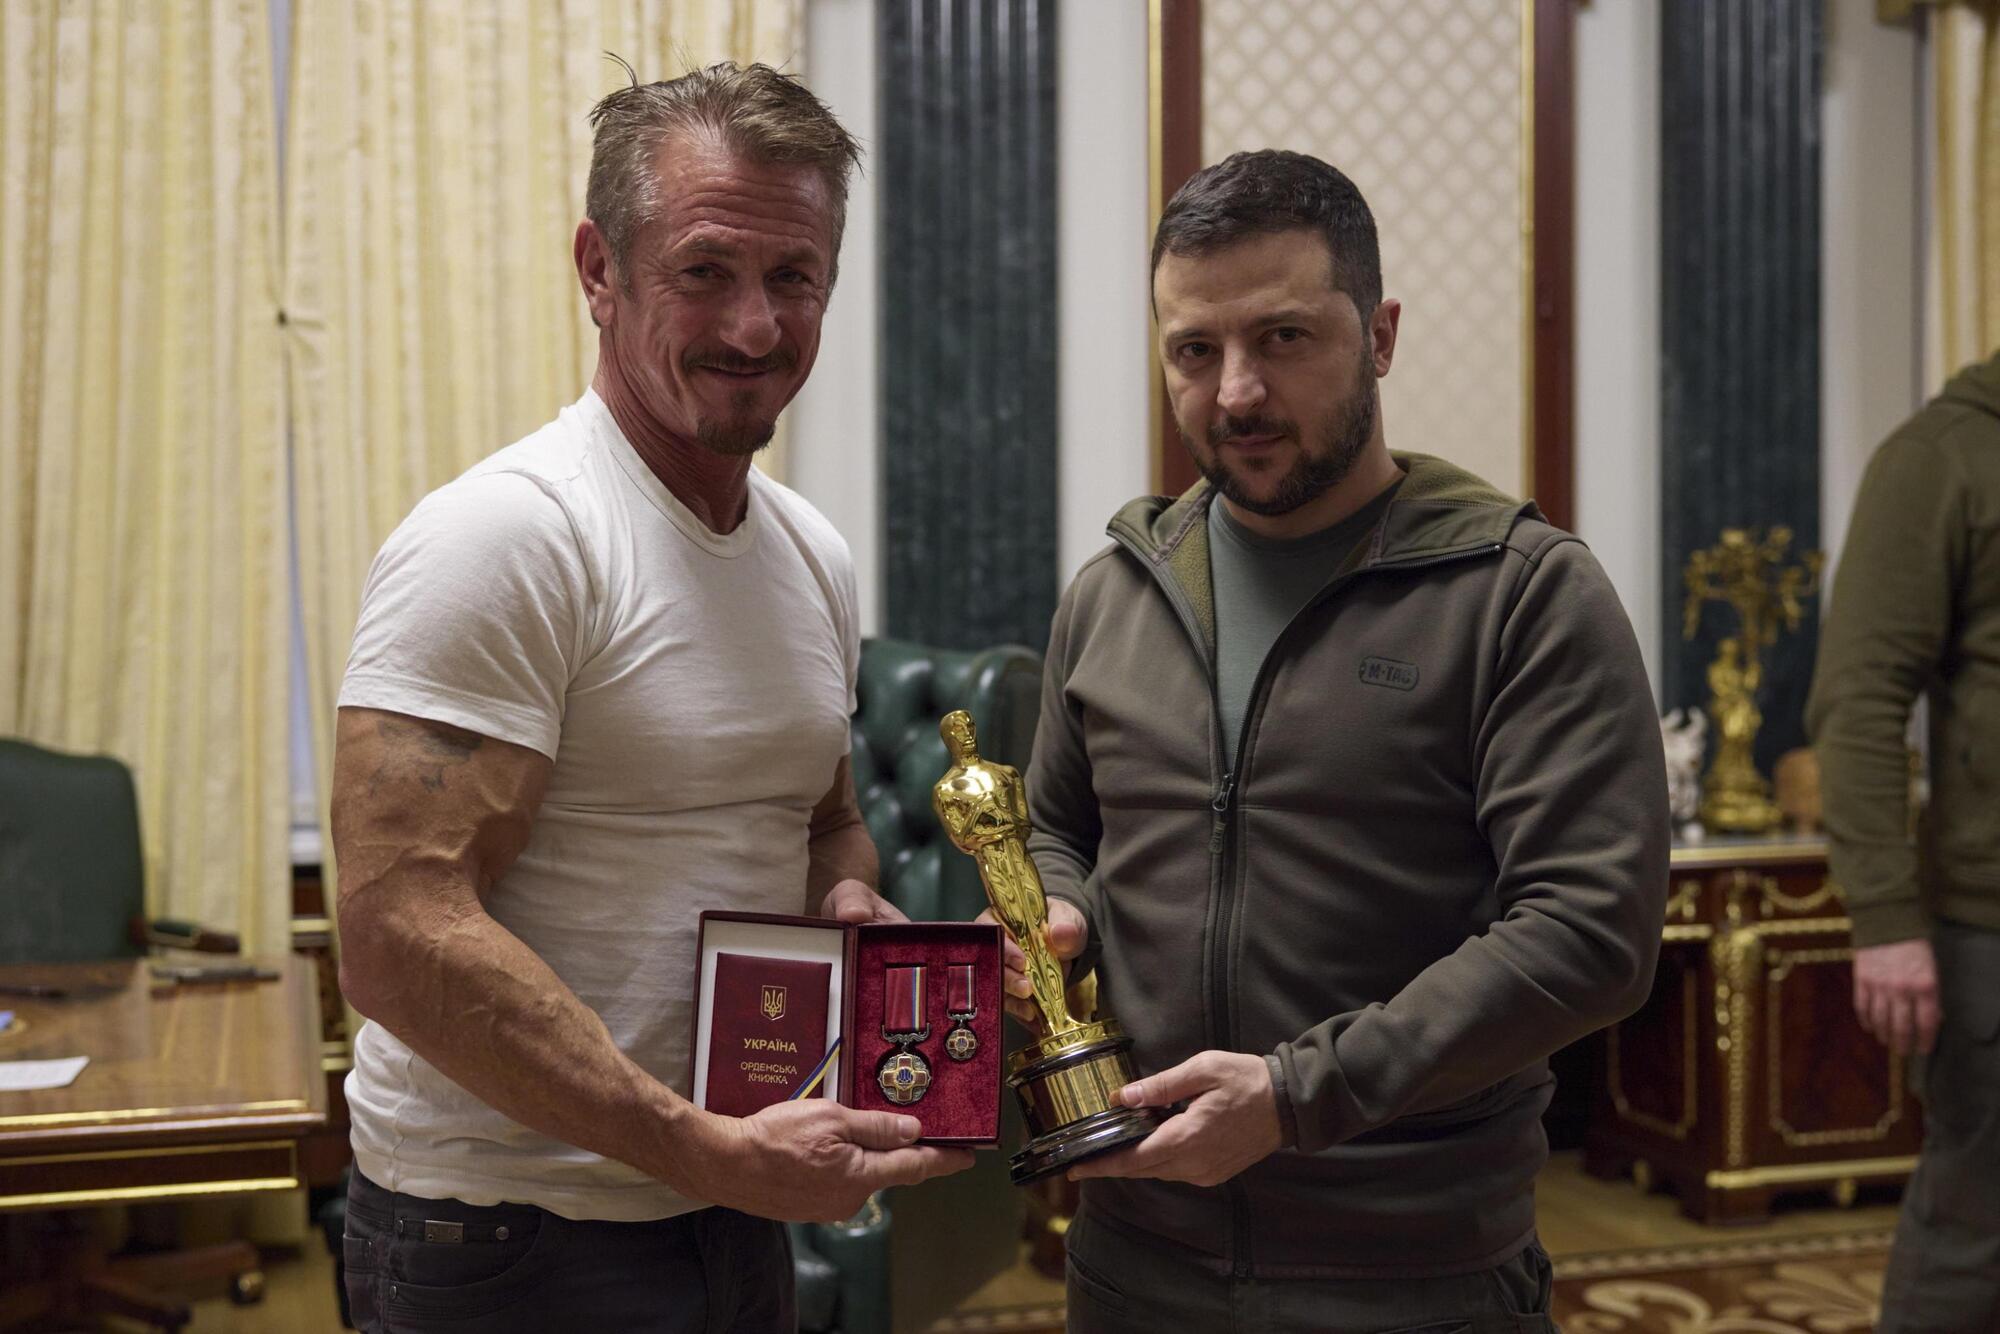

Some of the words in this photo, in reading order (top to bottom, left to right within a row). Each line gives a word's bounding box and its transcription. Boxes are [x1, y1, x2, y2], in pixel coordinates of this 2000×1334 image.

[743, 1038, 798, 1053] УКРАЇНА
[740, 1061, 798, 1075] ОРДЕНСЬКА
[748, 1072, 788, 1085] КНИЖКА
